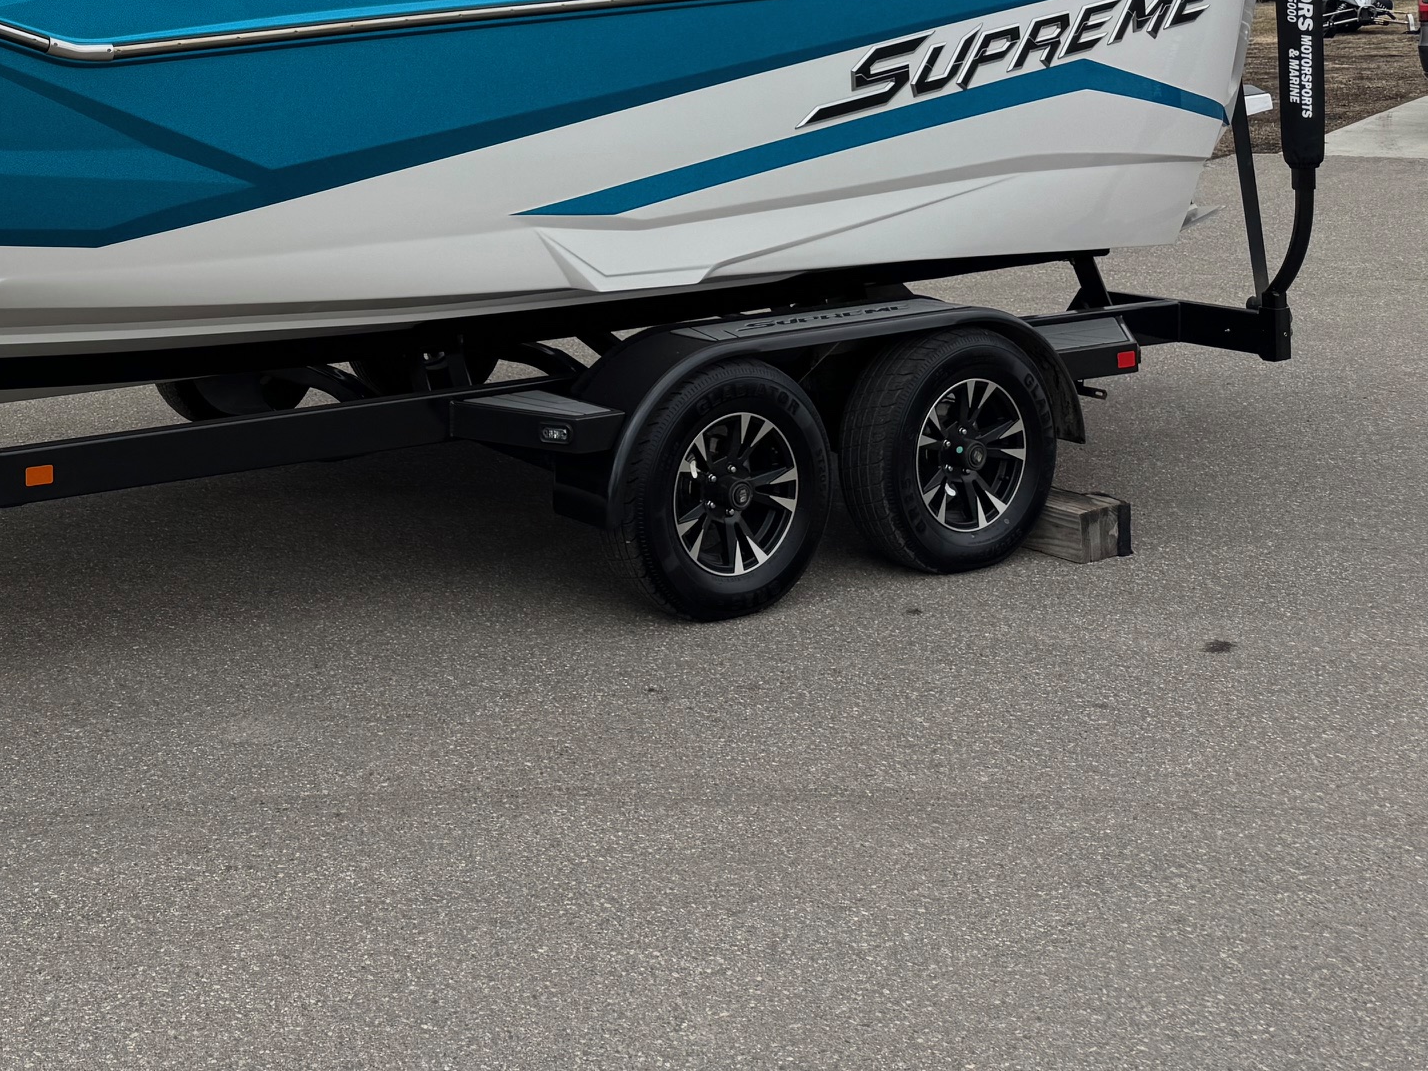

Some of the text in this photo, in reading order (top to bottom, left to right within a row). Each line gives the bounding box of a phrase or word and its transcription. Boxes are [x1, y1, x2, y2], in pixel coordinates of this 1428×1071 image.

[1288, 48, 1300, 104] & MARINE
[1300, 34, 1313, 119] MOTORSPORTS
